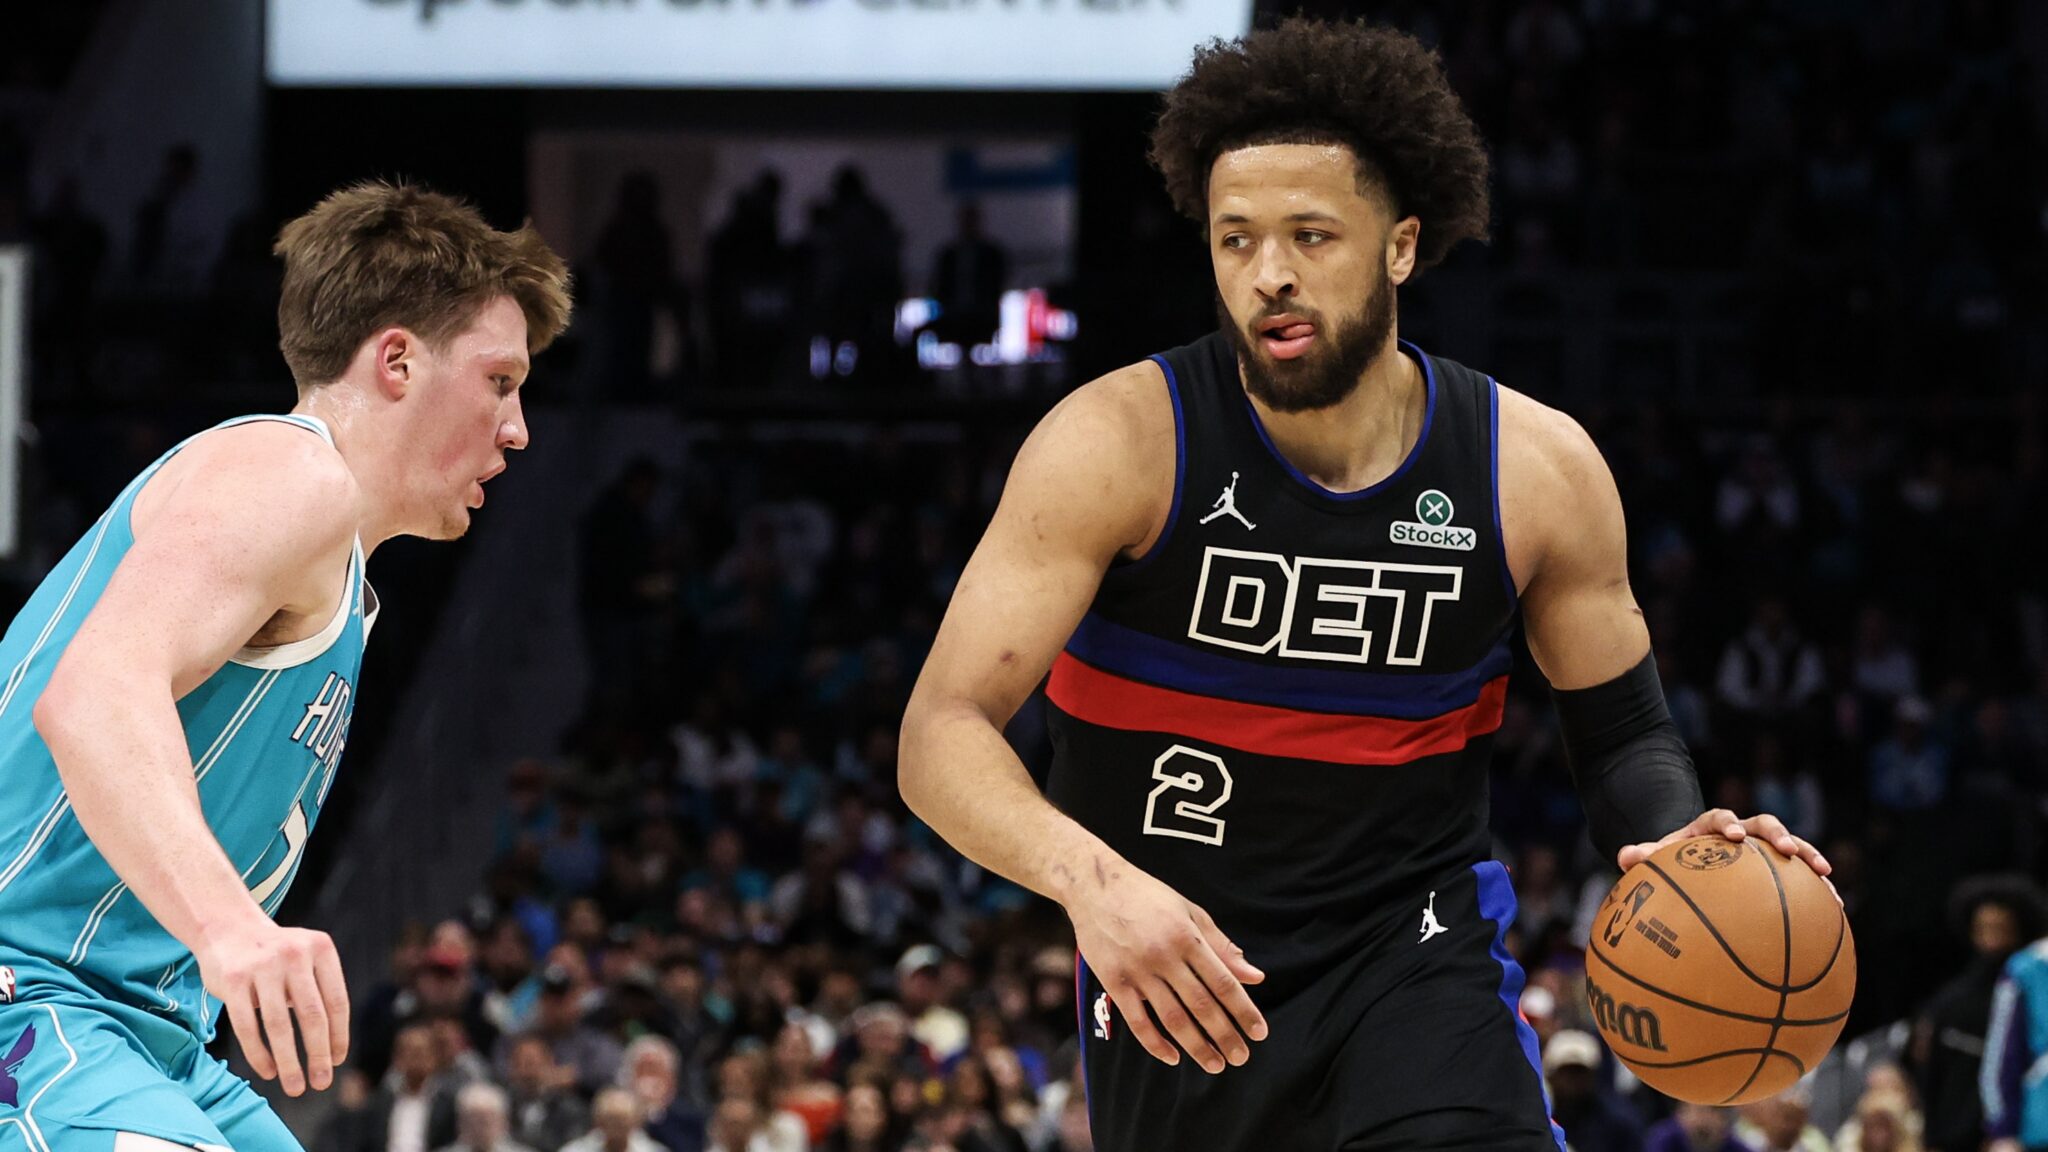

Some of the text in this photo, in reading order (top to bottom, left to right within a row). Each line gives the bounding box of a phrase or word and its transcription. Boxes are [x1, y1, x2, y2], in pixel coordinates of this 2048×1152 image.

[1393, 524, 1473, 548] StockX
[1188, 546, 1463, 666] DET
[1143, 744, 1233, 846] 2
